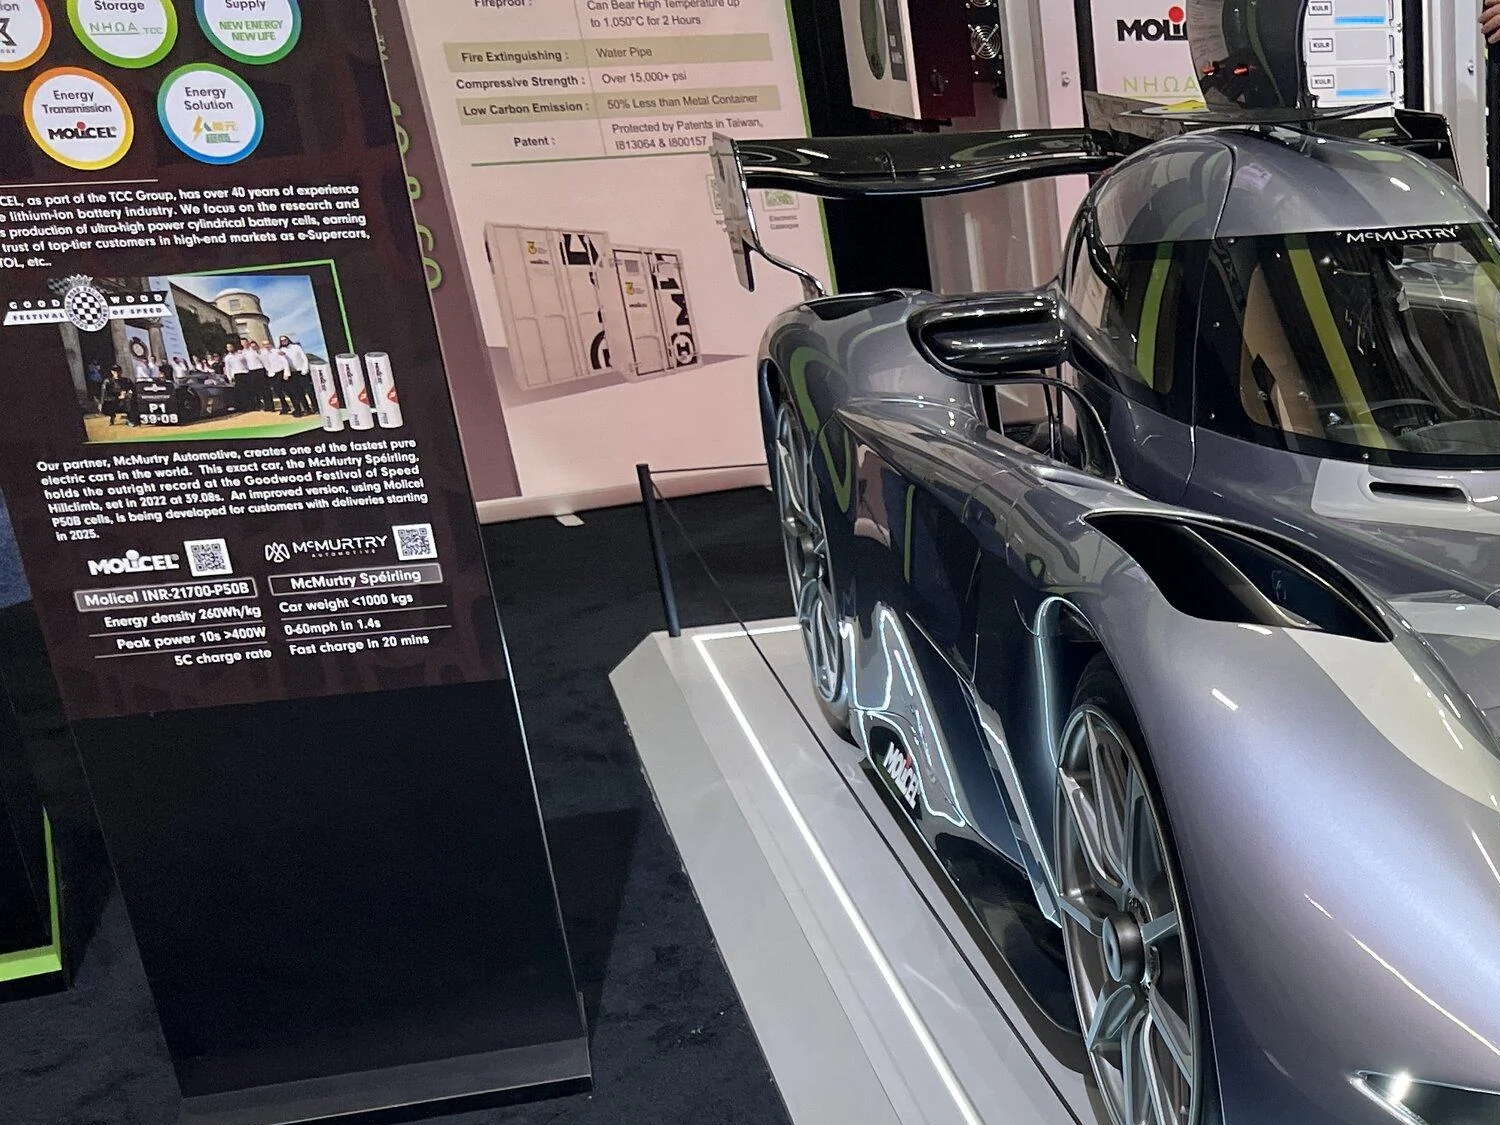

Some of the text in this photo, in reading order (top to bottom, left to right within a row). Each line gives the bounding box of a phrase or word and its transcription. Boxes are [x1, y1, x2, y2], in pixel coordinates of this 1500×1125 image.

[94, 0, 145, 13] Storage
[226, 0, 266, 11] Supply
[219, 20, 283, 30] NEW ENERGY
[671, 15, 701, 25] Hours
[231, 32, 276, 41] NEW LIFE
[461, 51, 562, 63] Fire Extinguishing
[595, 47, 652, 58] Water Pipe
[456, 75, 578, 91] Compressive Strength
[601, 74, 626, 84] Over
[53, 90, 94, 102] Energy
[185, 87, 226, 99] Energy
[42, 103, 112, 114] Transmission
[184, 100, 234, 111] Solution
[463, 102, 583, 116] Low Carbon Emission
[607, 95, 758, 109] 50% Less than Metal Container
[611, 120, 713, 134] Protected Patents
[513, 137, 549, 147] Patent
[44, 184, 359, 208] part TCC Group, over years experience
[9, 209, 74, 222] lithium-ion
[76, 208, 121, 220] battery
[124, 206, 177, 218] industry.
[179, 204, 200, 214] We
[203, 204, 236, 214] focus
[238, 204, 255, 213] on
[280, 199, 333, 211] research
[335, 198, 360, 209] and
[9, 225, 73, 240] production
[90, 221, 145, 235] ultra-high
[147, 222, 185, 235] power
[187, 217, 246, 232] cylindrical
[247, 217, 289, 228] battery
[291, 215, 320, 227] cells,
[322, 213, 366, 226] earning
[2, 229, 370, 253] trust top-tier customers high-end markets e-Supercars,
[12, 307, 163, 322] FESTIVAL OF SPEED
[149, 403, 166, 414] P1
[36, 440, 416, 472] Our partner, McMurtry Automotive, creates fastest pure
[41, 456, 362, 486] electric cars world. This exact car, McMurtry
[44, 464, 421, 499] holds outright record at Goodwood Festival Speed
[48, 478, 424, 514] Hillclimb, 2022 39.08s. improved version, using Molicel
[51, 492, 428, 527] P50B cells, being developed for customers with deliveries starting
[69, 528, 100, 540] 2025.
[311, 549, 377, 559] AUTOMOTIVE
[290, 571, 423, 589] McMurtry Spéirling
[84, 582, 249, 606] Molicel INR-21700-P50B
[279, 593, 413, 613] Car weight <1000 kgs
[104, 606, 262, 628] Energy density 260Wh/kg
[284, 618, 381, 635] 0-60mph 1.4s
[116, 626, 266, 650] Peak power 10s >400W
[289, 634, 429, 655] Fast charge 20 mins
[174, 649, 272, 666] 5C charge rate
